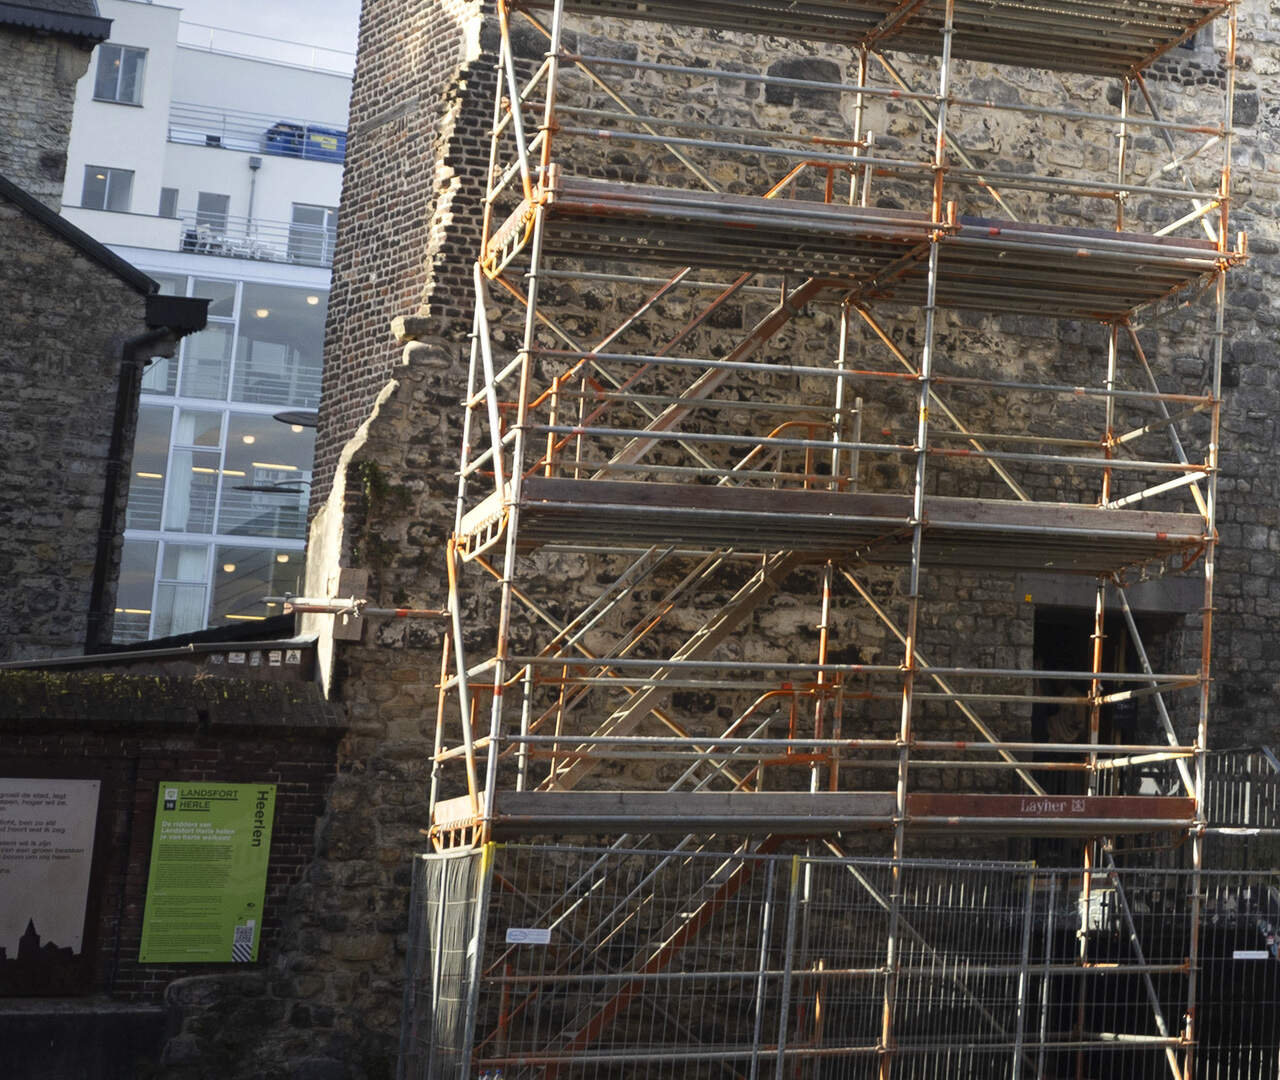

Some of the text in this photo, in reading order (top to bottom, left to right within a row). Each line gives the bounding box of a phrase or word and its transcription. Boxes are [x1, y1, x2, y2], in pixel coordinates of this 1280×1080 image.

[180, 789, 239, 798] LANDSFORT
[1020, 799, 1067, 813] Layher
[251, 790, 269, 847] Heerlen
